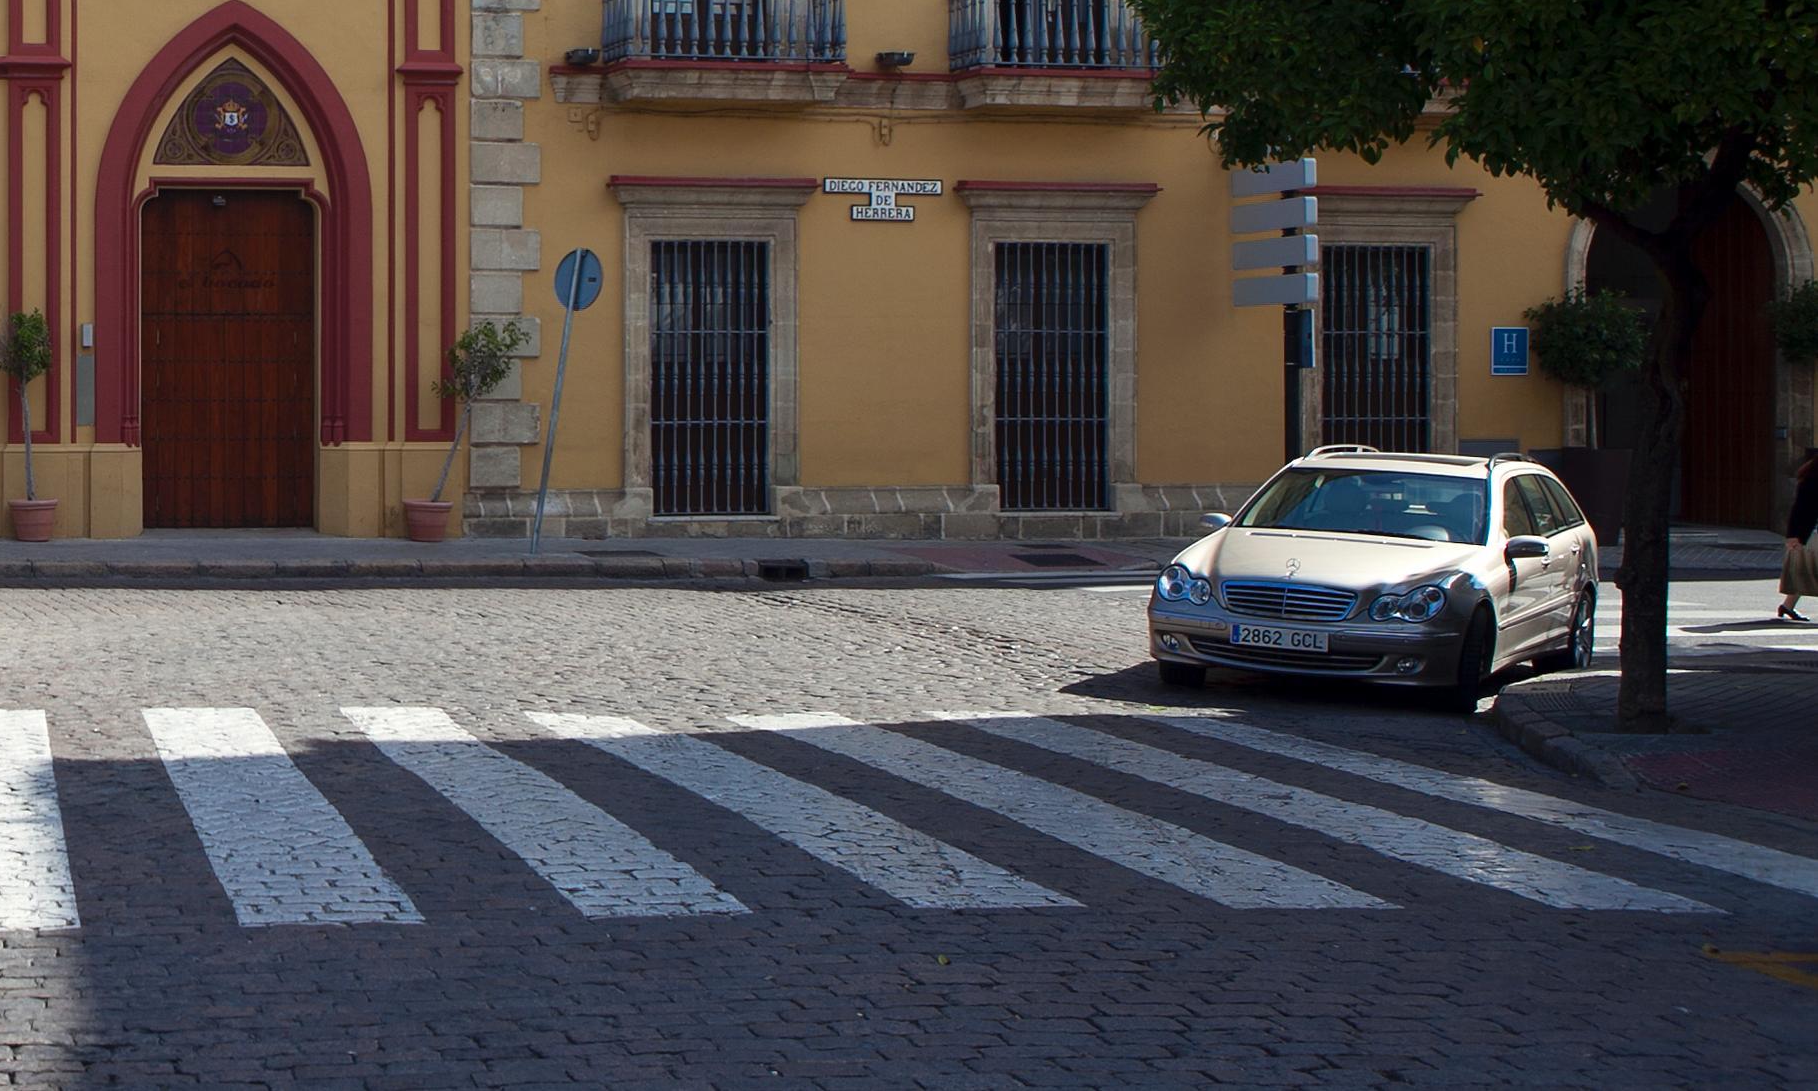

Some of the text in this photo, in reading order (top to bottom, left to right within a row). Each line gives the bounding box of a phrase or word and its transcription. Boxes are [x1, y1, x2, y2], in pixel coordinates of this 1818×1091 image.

[868, 181, 938, 193] FERNANDEZ
[875, 195, 892, 206] DE
[856, 208, 911, 219] HERRERA
[1503, 333, 1518, 354] H
[1241, 627, 1323, 649] 2862 GCL
